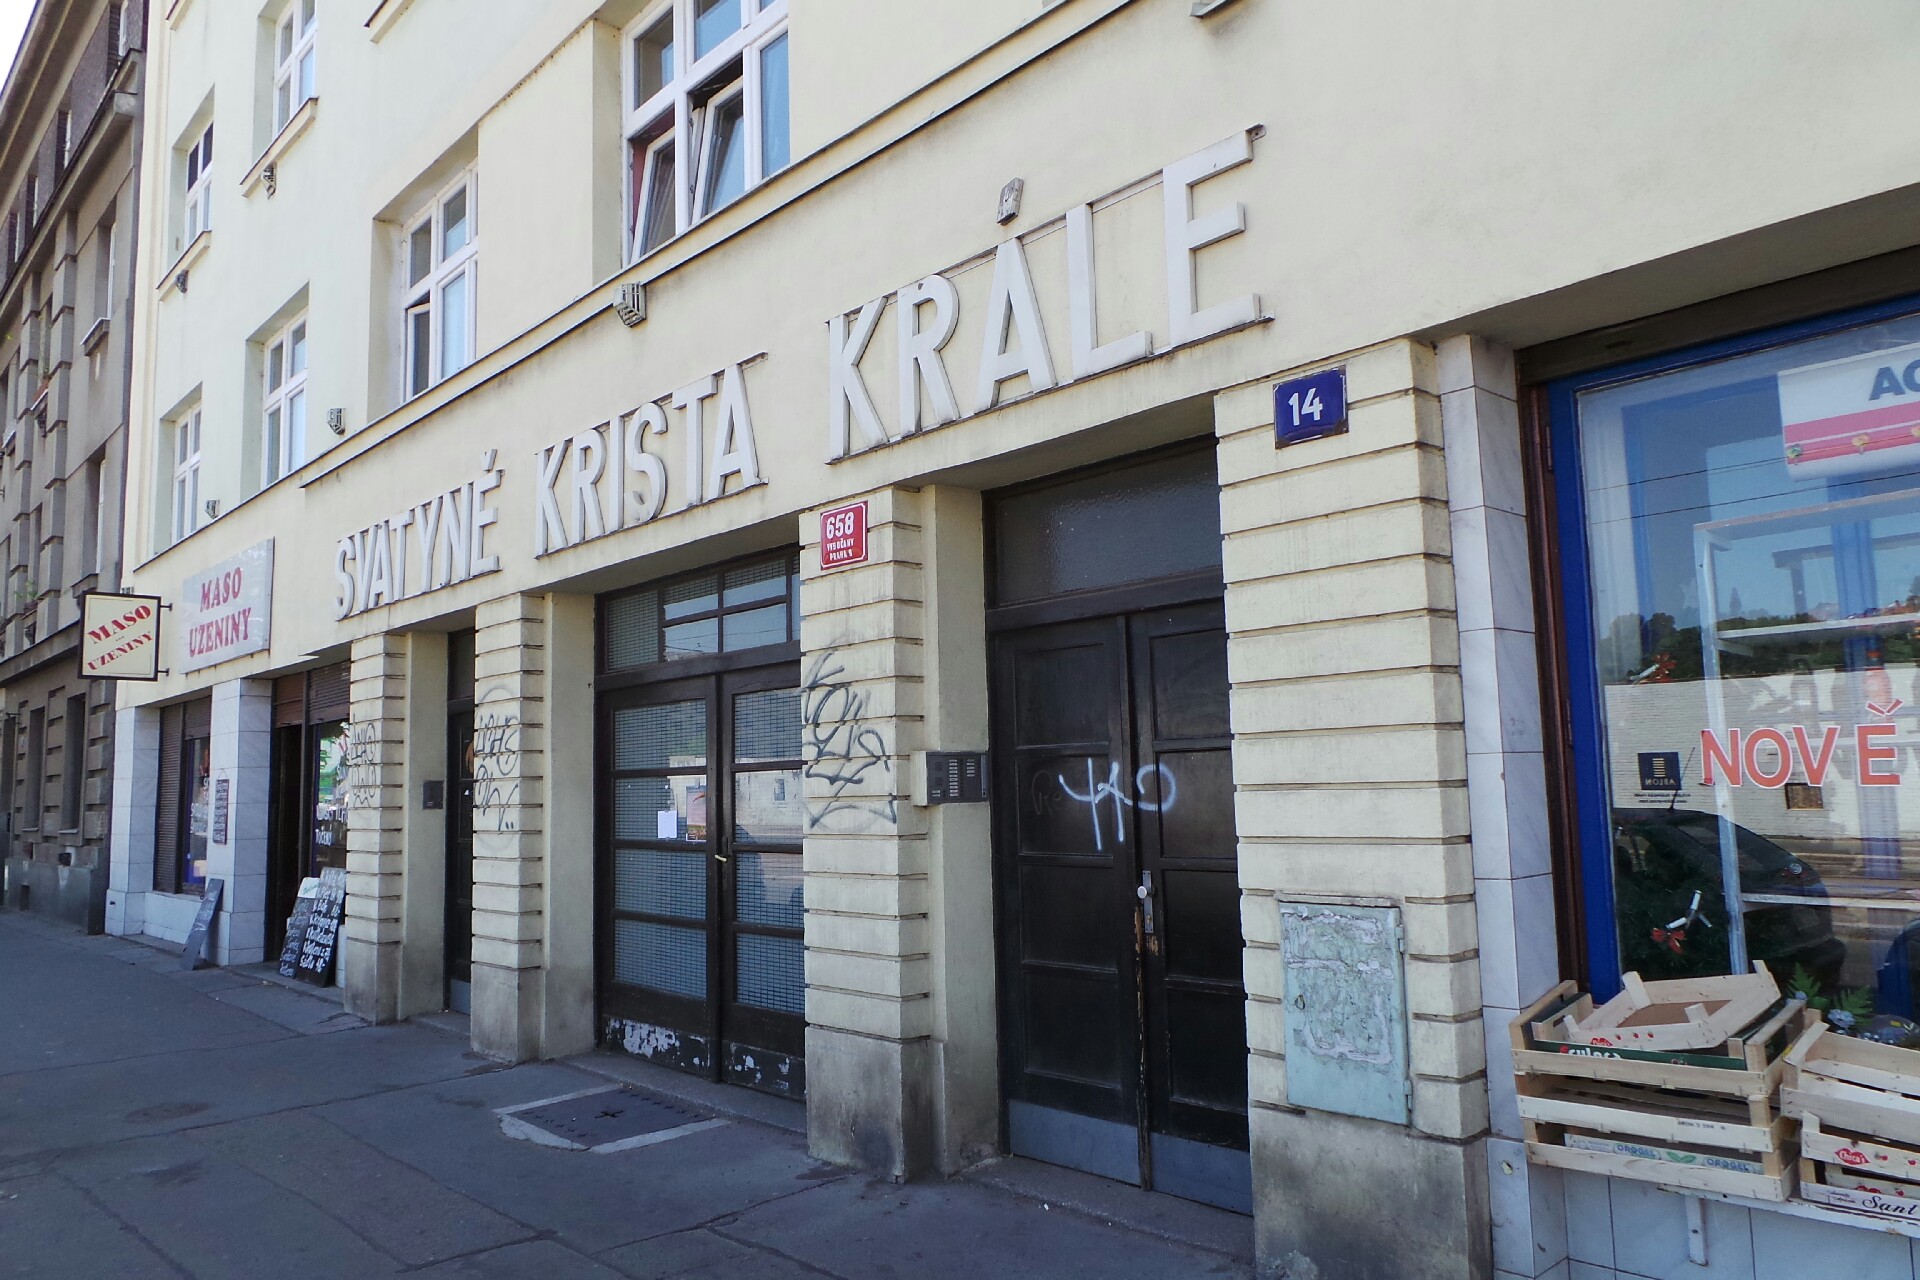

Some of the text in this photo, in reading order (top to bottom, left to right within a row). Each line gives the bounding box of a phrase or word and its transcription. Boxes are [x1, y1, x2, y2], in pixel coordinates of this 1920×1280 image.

[1287, 387, 1323, 426] 14
[335, 449, 502, 621] SVATYNĚ
[535, 360, 764, 558] KRISTA
[826, 511, 854, 539] 658
[827, 538, 854, 551] VYSOČANY
[829, 549, 847, 561] PRAHA
[200, 566, 242, 613] MASO
[87, 605, 151, 644] MASO
[189, 607, 252, 657] UZENINY
[88, 631, 153, 670] UZENINY
[1700, 698, 1904, 789] NOVĚ
[1862, 1195, 1918, 1215] Sant
